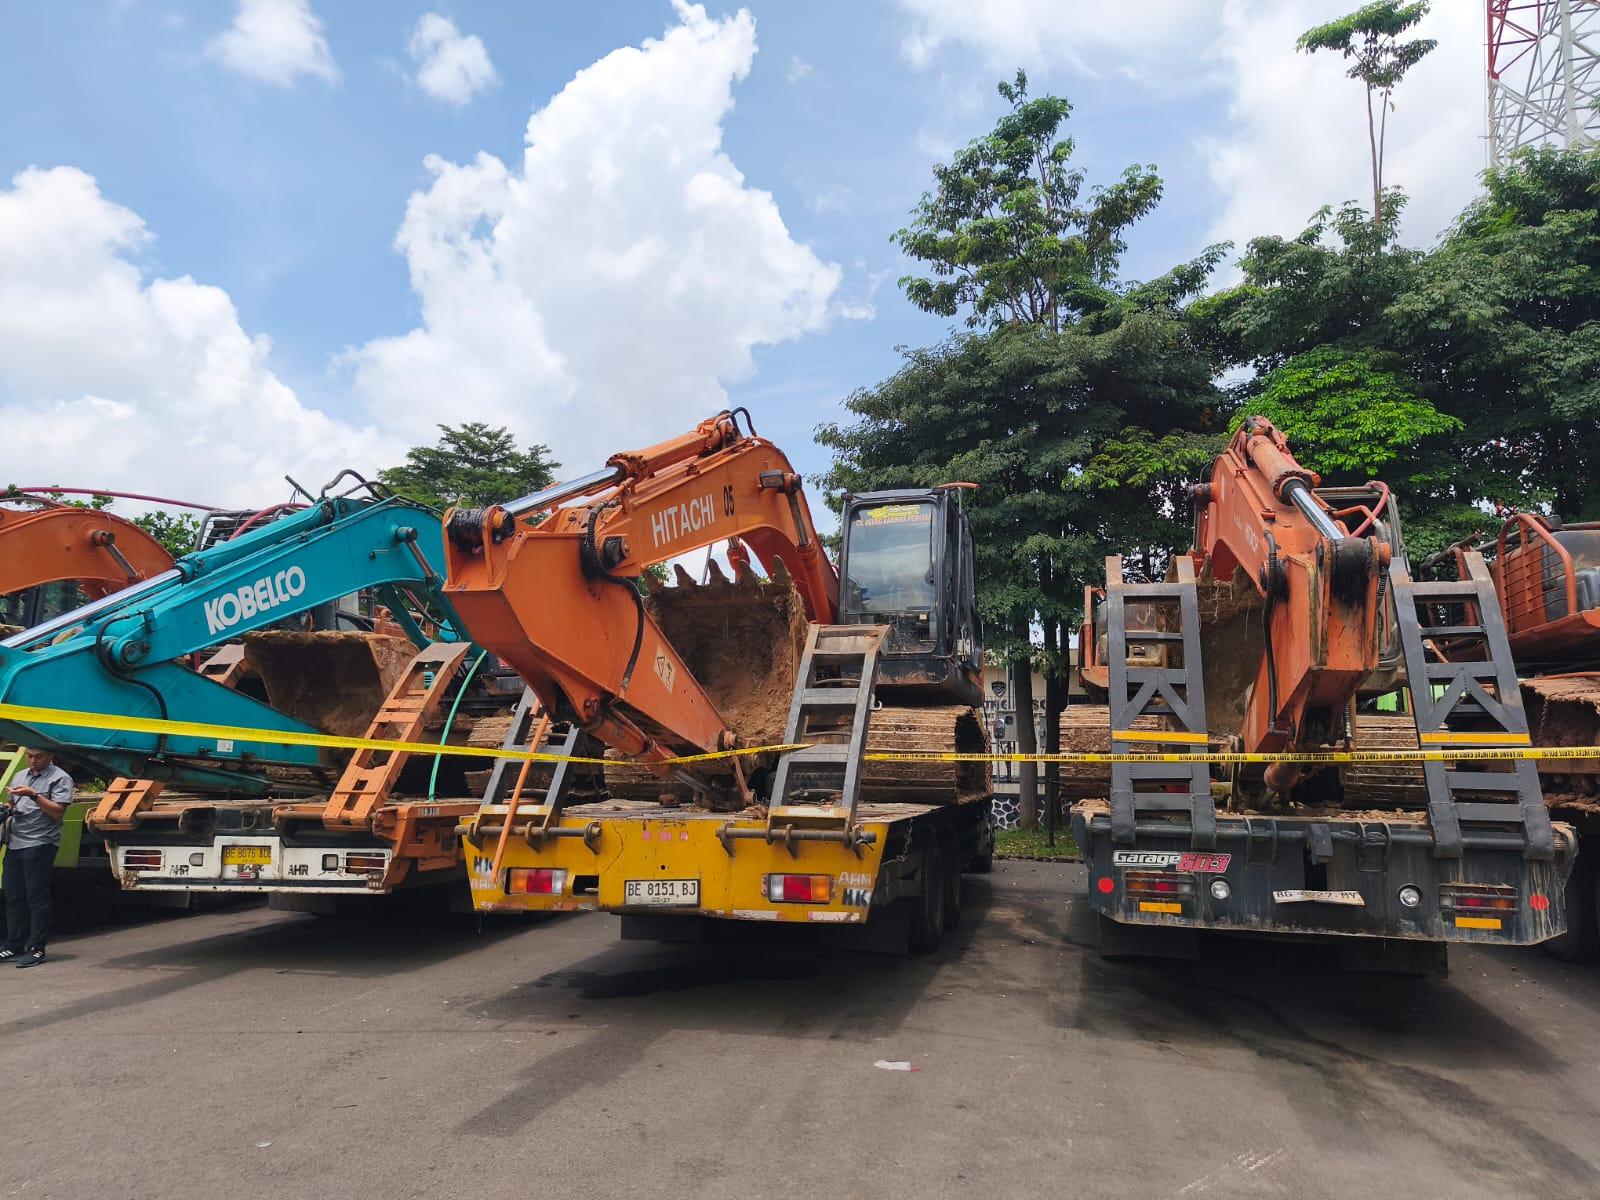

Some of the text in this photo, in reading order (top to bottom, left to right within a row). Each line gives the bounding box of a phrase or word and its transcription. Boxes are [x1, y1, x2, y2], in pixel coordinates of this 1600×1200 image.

[651, 484, 735, 548] HITACHI 05
[203, 565, 306, 636] KOBELCO
[1113, 851, 1179, 867] Garage
[288, 864, 309, 876] AHR
[628, 883, 696, 896] BE 8151 BJ
